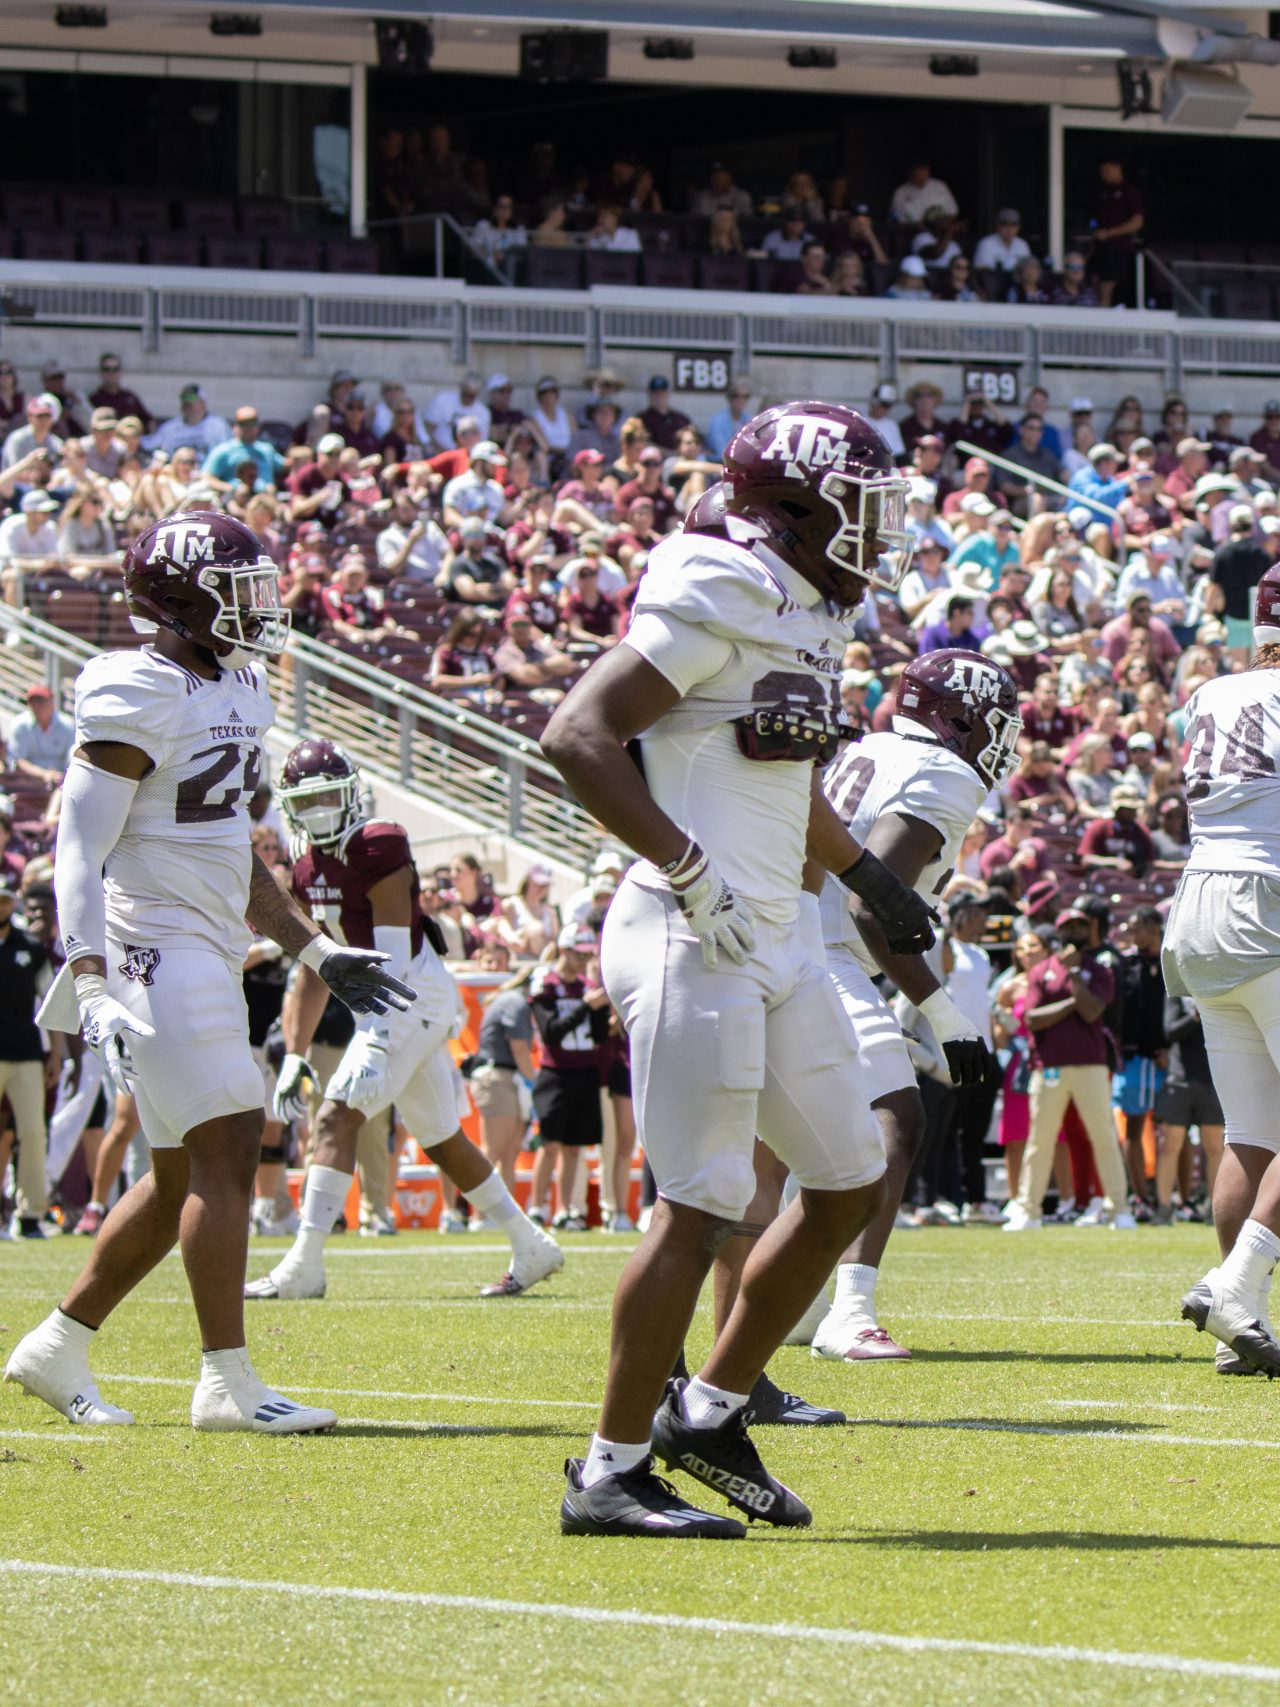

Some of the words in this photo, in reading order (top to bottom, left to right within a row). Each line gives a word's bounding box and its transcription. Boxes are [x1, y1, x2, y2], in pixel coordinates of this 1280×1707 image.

[677, 358, 728, 389] FB8
[966, 371, 1016, 401] FB9
[679, 1452, 777, 1513] ADIZERO
